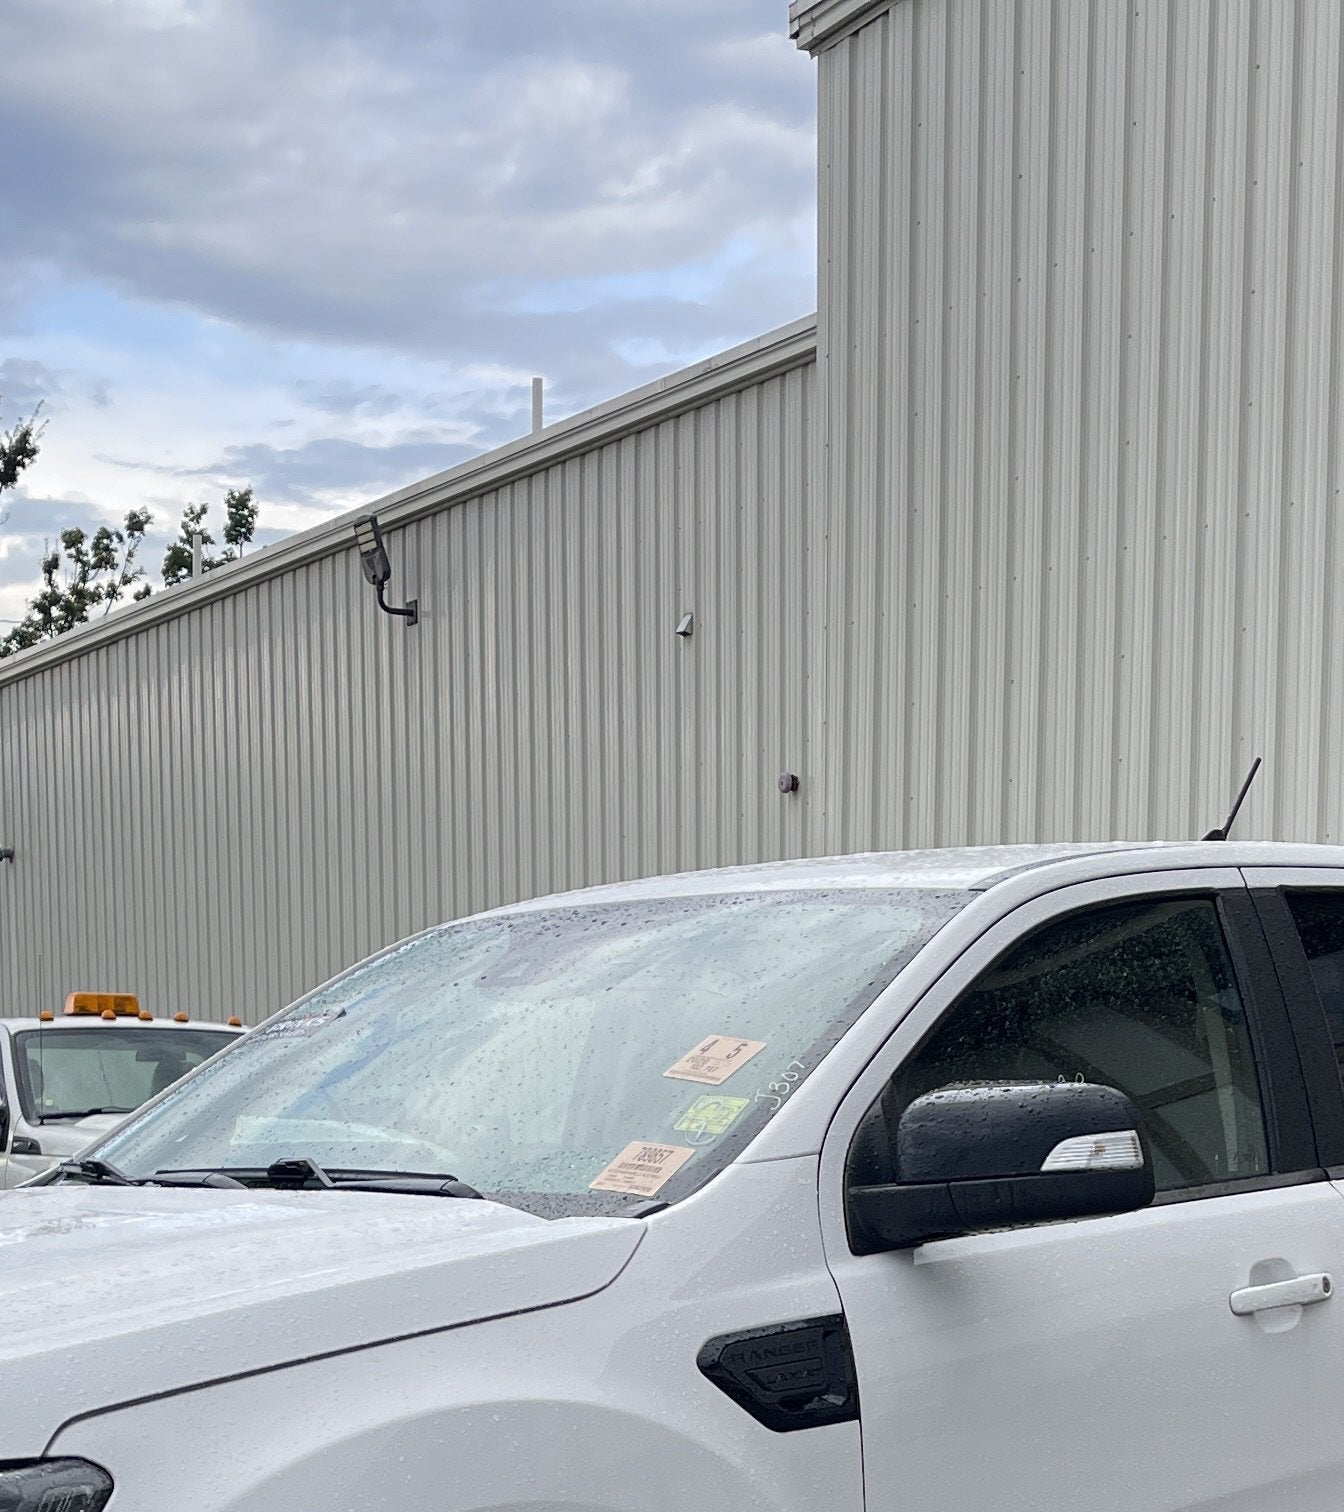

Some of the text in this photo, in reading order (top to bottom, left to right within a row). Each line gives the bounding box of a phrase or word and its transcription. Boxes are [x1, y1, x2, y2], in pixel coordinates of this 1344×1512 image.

[726, 1043, 749, 1060] 5
[754, 1060, 806, 1111] J307
[730, 1340, 819, 1362] RANGER
